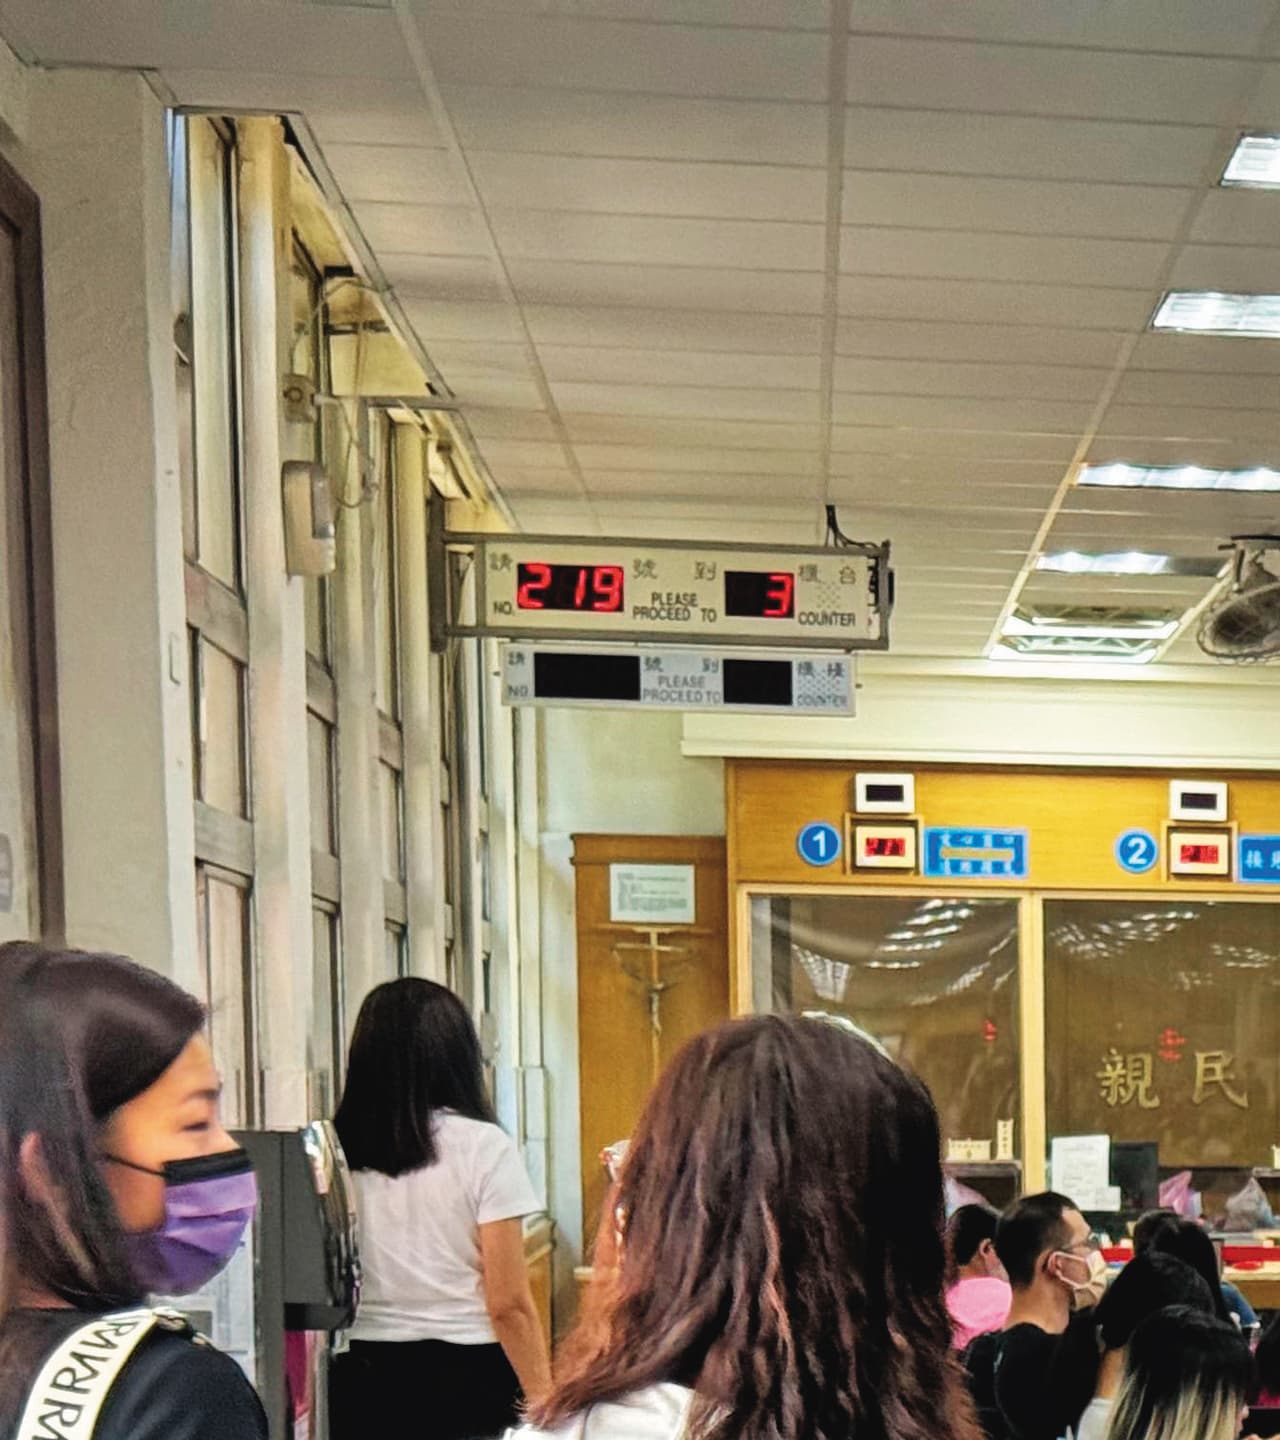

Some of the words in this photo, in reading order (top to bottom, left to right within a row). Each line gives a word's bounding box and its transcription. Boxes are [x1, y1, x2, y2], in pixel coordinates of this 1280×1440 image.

[517, 562, 624, 613] 219
[762, 573, 795, 619] 3
[651, 591, 698, 608] PLEASE
[632, 607, 691, 622] PROCEED
[701, 608, 718, 623] TO
[798, 612, 857, 626] COUNTER
[657, 675, 706, 690] PLEASE
[642, 687, 701, 704] PROCEED
[703, 690, 722, 705] TO
[812, 829, 826, 858] 1
[1127, 837, 1148, 866] 2
[49, 1351, 112, 1395] RM
